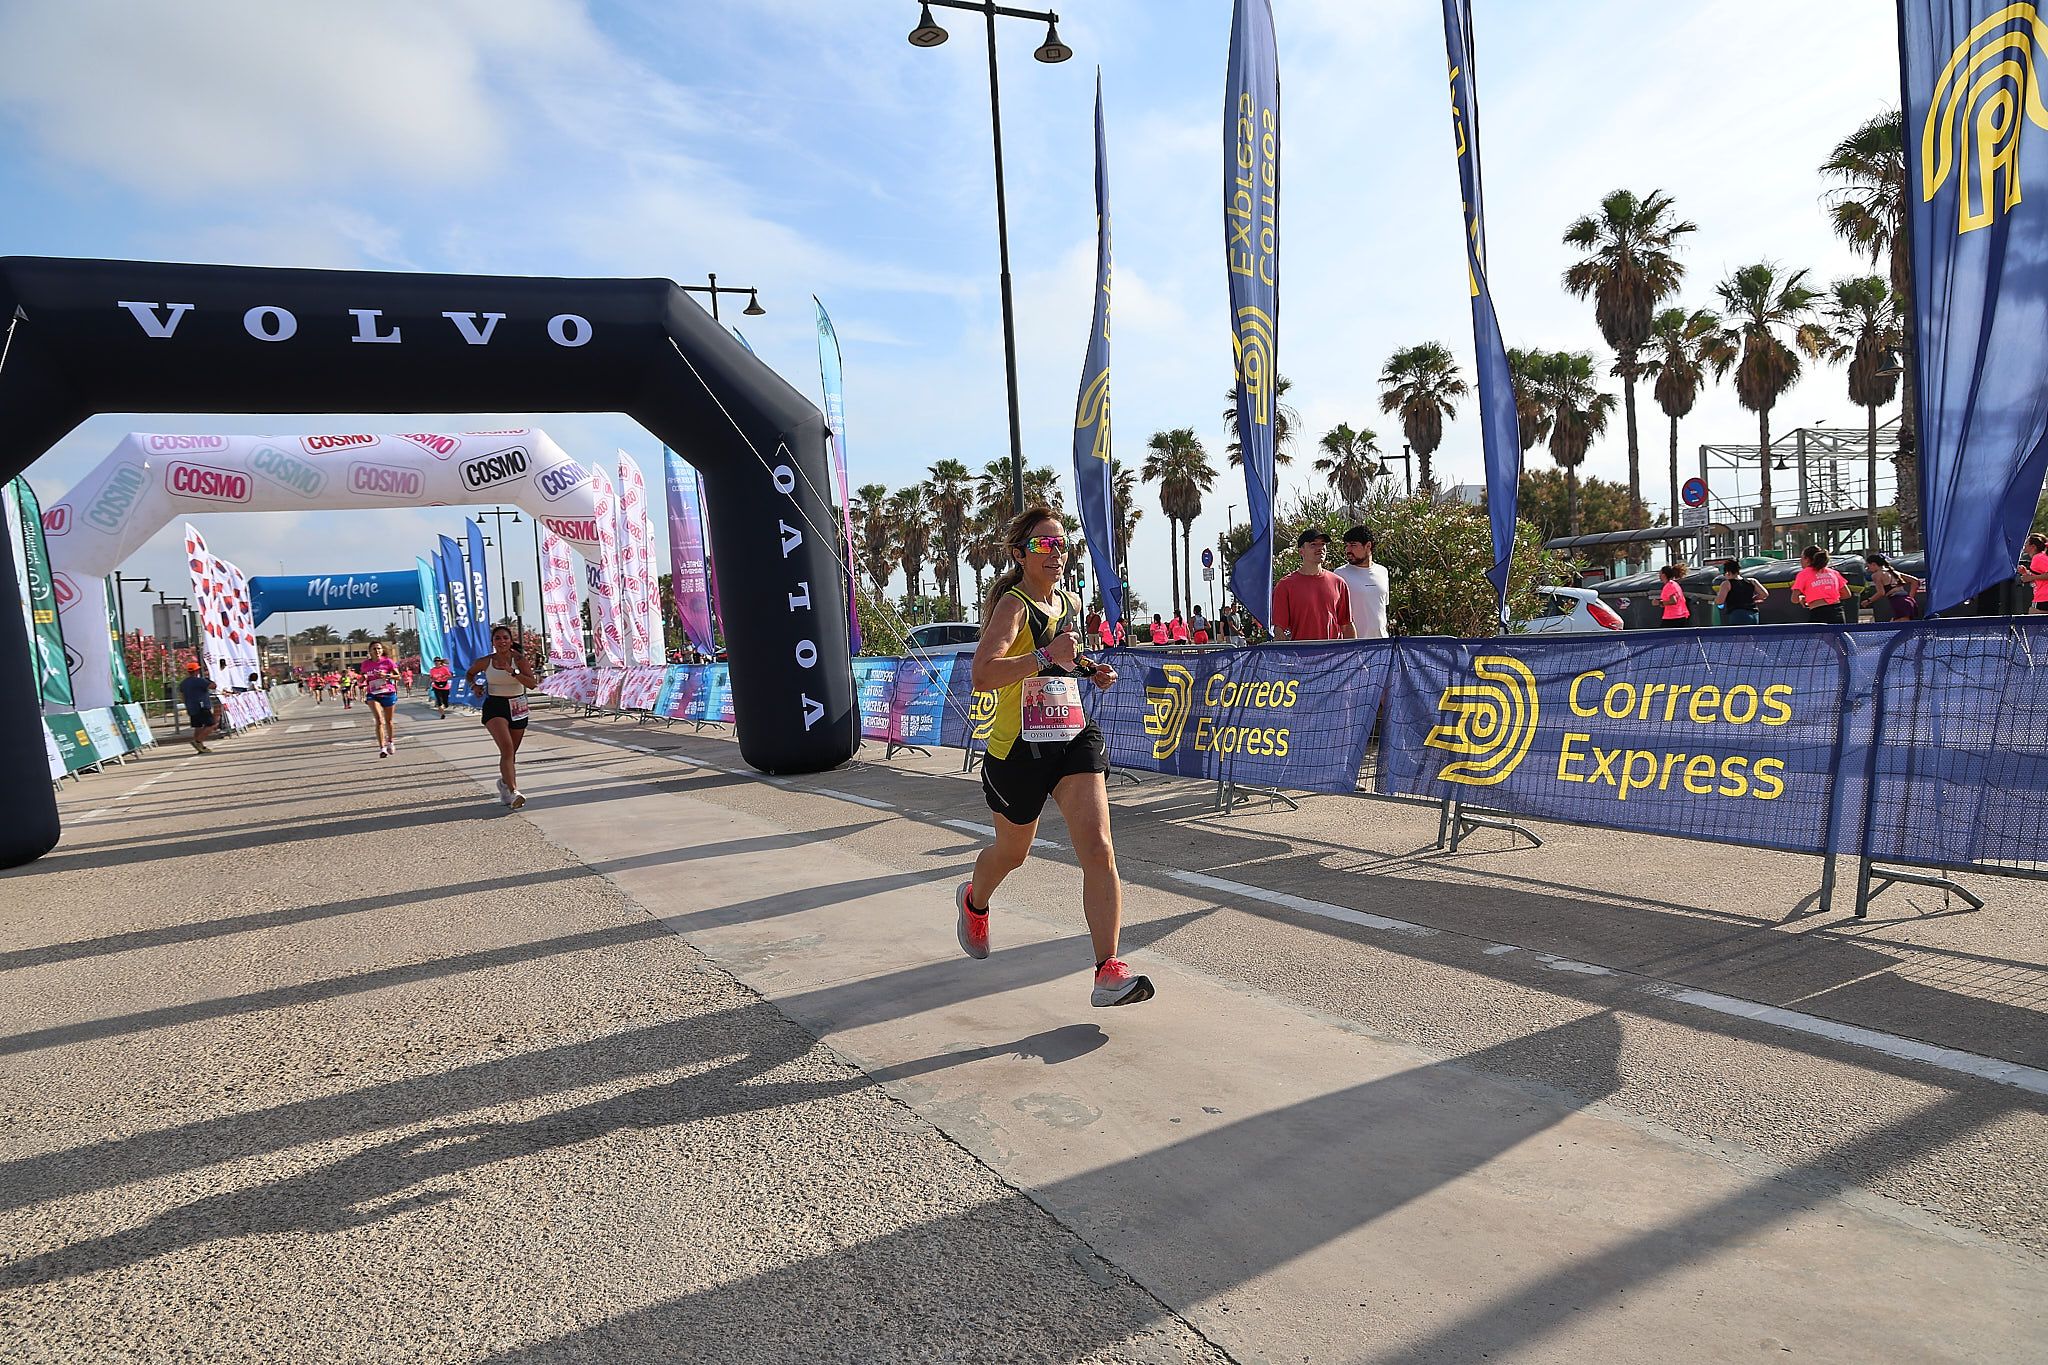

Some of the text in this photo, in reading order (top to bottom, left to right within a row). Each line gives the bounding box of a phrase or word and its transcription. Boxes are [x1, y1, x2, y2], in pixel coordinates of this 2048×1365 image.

[118, 300, 593, 347] VOLVO
[150, 434, 222, 450] COSMO
[307, 433, 373, 450] COSMO
[173, 466, 246, 500] COSMO
[254, 449, 320, 494] COSMO
[354, 466, 419, 495] COSMO
[466, 450, 527, 486] COSMO
[90, 467, 144, 528] COSMO
[307, 576, 379, 605] Marlene
[453, 581, 469, 628] AVON
[773, 464, 825, 731] VOLVO
[1045, 705, 1069, 717] 016
[1204, 674, 1300, 709] Correos
[1568, 670, 1794, 727] Correos
[1195, 717, 1290, 762] Express
[1557, 732, 1786, 801] Express
